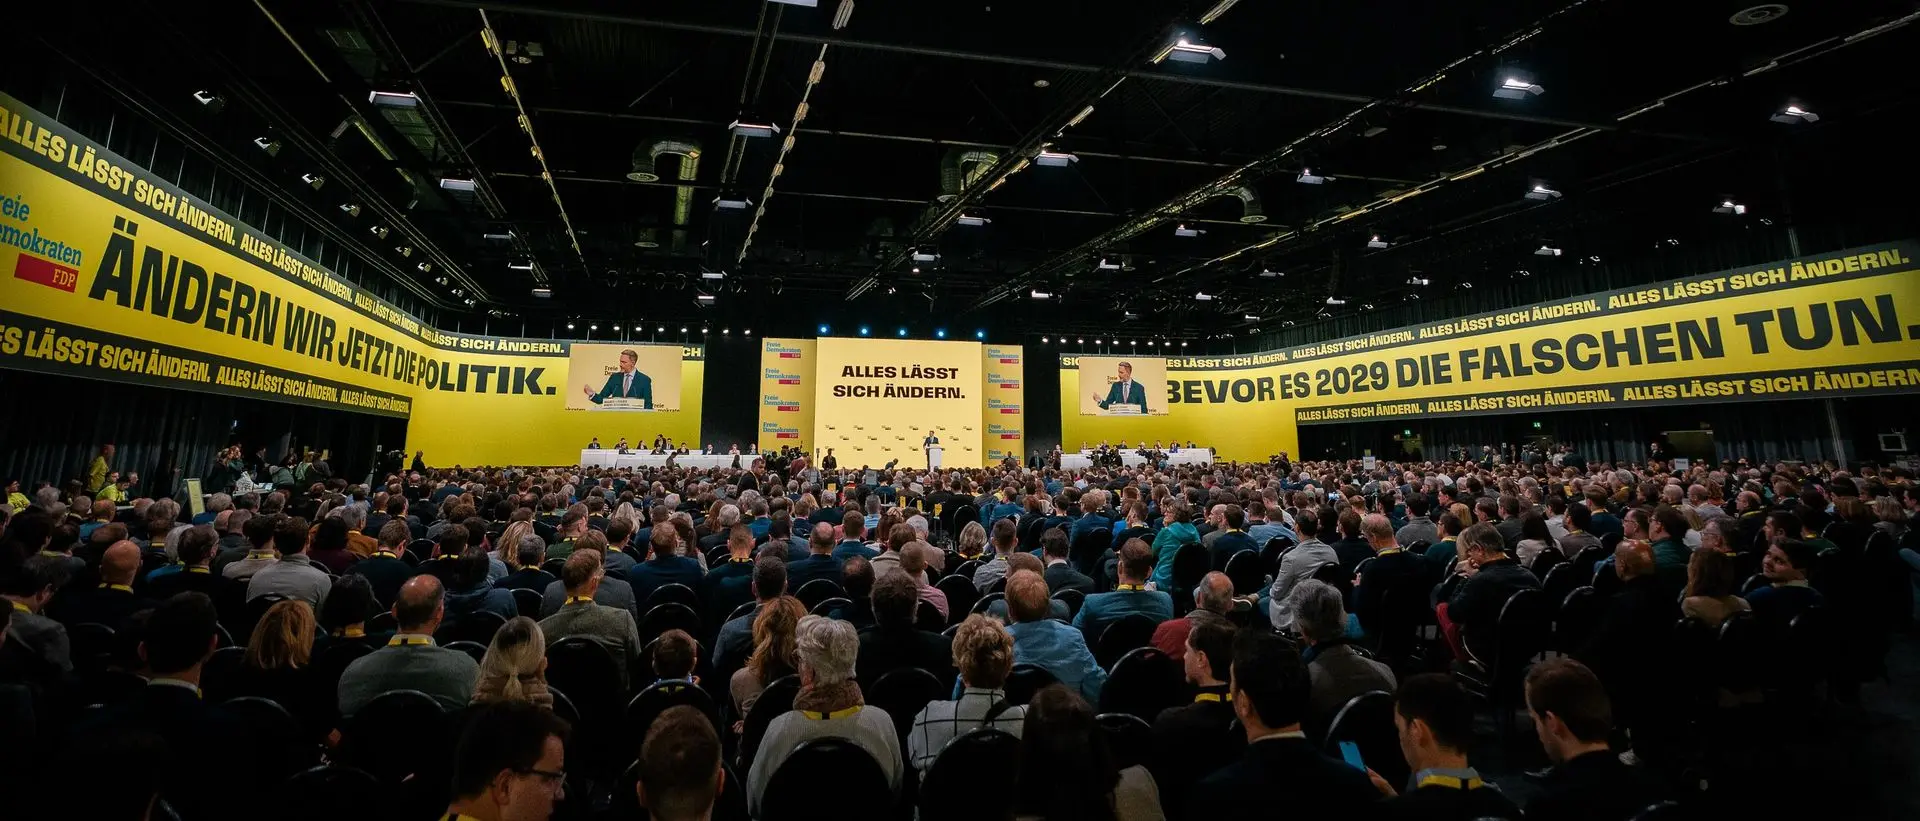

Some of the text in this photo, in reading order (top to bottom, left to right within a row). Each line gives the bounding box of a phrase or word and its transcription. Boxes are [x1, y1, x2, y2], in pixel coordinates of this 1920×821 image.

[53, 268, 75, 287] FDP
[68, 145, 134, 194] LÄSST
[134, 180, 176, 216] SICH
[176, 198, 235, 245] ÄNDERN.
[240, 234, 272, 262] ALLES
[273, 249, 303, 277] LÄSST
[302, 266, 323, 287] SICH
[322, 274, 352, 303] ÄNDERN.
[355, 293, 372, 311] ALLES
[372, 301, 390, 320] LÄSST
[431, 331, 459, 347] LÄSST
[460, 338, 495, 350] SICH
[497, 340, 564, 353] ÄNDERN.
[88, 215, 556, 395] ÄNDERN WIR JETZT DIE POLITIK.
[1183, 358, 1221, 367] LÄSST
[1223, 357, 1251, 367] SICH
[1253, 352, 1288, 365] ÄNDERN.
[1293, 348, 1316, 359] ALLES
[1317, 342, 1344, 355] LÄSST
[1345, 338, 1368, 350] SICH
[1370, 331, 1414, 347] ÄNDERN.
[1420, 324, 1453, 338] ALLES
[1454, 317, 1493, 333] LÄSST
[1496, 311, 1530, 326] SICH
[1532, 300, 1600, 320] ÄNDERN.
[1609, 289, 1660, 308] ALLES
[1663, 278, 1726, 300] LÄSST
[1730, 268, 1786, 289] SICH
[1791, 250, 1909, 280] ÄNDERN.
[24, 328, 98, 365] LÄSST
[99, 345, 146, 372] SICH
[146, 350, 210, 382] ÄNDERN.
[216, 366, 251, 388] ALLES
[251, 370, 284, 393] LÄSST
[284, 379, 305, 396] SICH
[305, 380, 338, 402] ÄNDERN.
[340, 390, 359, 405] ALLES
[359, 392, 377, 408] LÄSST
[377, 397, 390, 410] SICH
[834, 384, 965, 398] SICH ÄNDERN.
[842, 365, 958, 379] ALLES LÄSST
[1280, 372, 1310, 399] ES
[1316, 362, 1389, 396] 2029
[1396, 353, 1452, 388] DIE
[1459, 316, 1724, 382] FALSCHEN
[1298, 411, 1321, 420] ALLES
[1322, 408, 1350, 419] LÄSST
[1351, 407, 1374, 417] SICH
[1376, 403, 1422, 416] ÄNDERN.
[1428, 400, 1462, 412] ALLES
[1464, 397, 1504, 410] LÄSST
[1507, 394, 1541, 407] SICH
[1544, 390, 1615, 405] ÄNDERN.
[1624, 385, 1677, 400] ALLES
[1680, 380, 1745, 397] LÄSST
[1750, 376, 1808, 393] SICH
